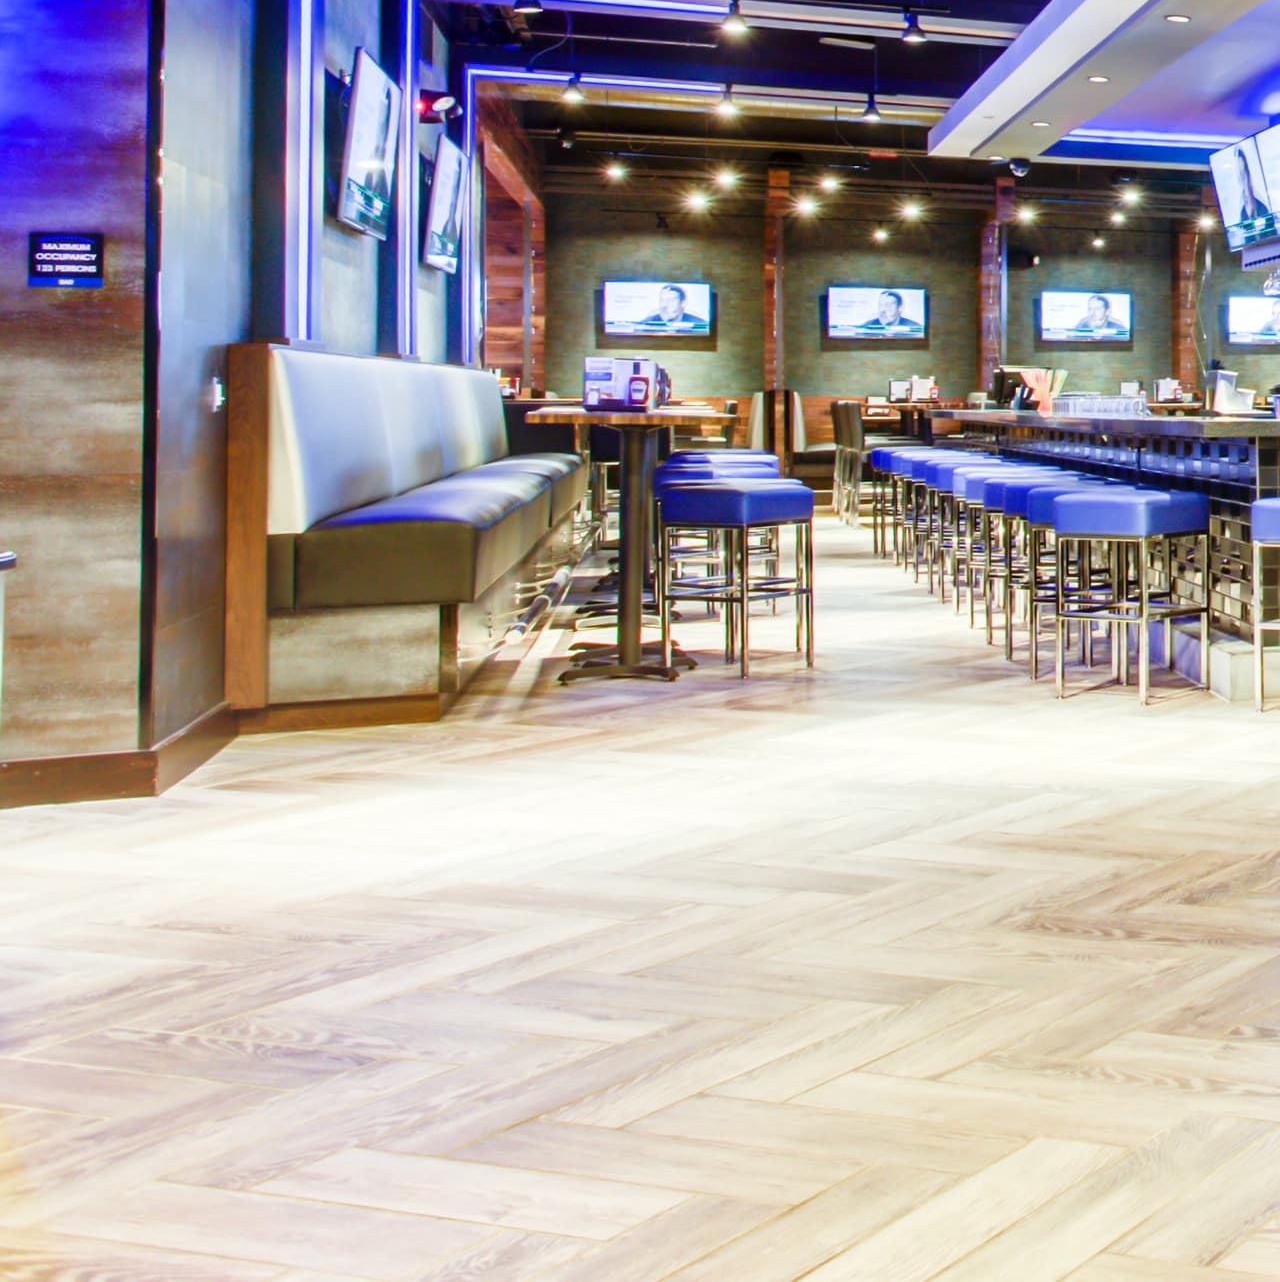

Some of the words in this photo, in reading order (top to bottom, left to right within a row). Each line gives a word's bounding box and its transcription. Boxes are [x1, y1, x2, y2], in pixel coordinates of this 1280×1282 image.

[41, 243, 91, 251] MAXIMUM
[35, 253, 97, 261] OCCUPANCY
[55, 264, 97, 273] PERSONS
